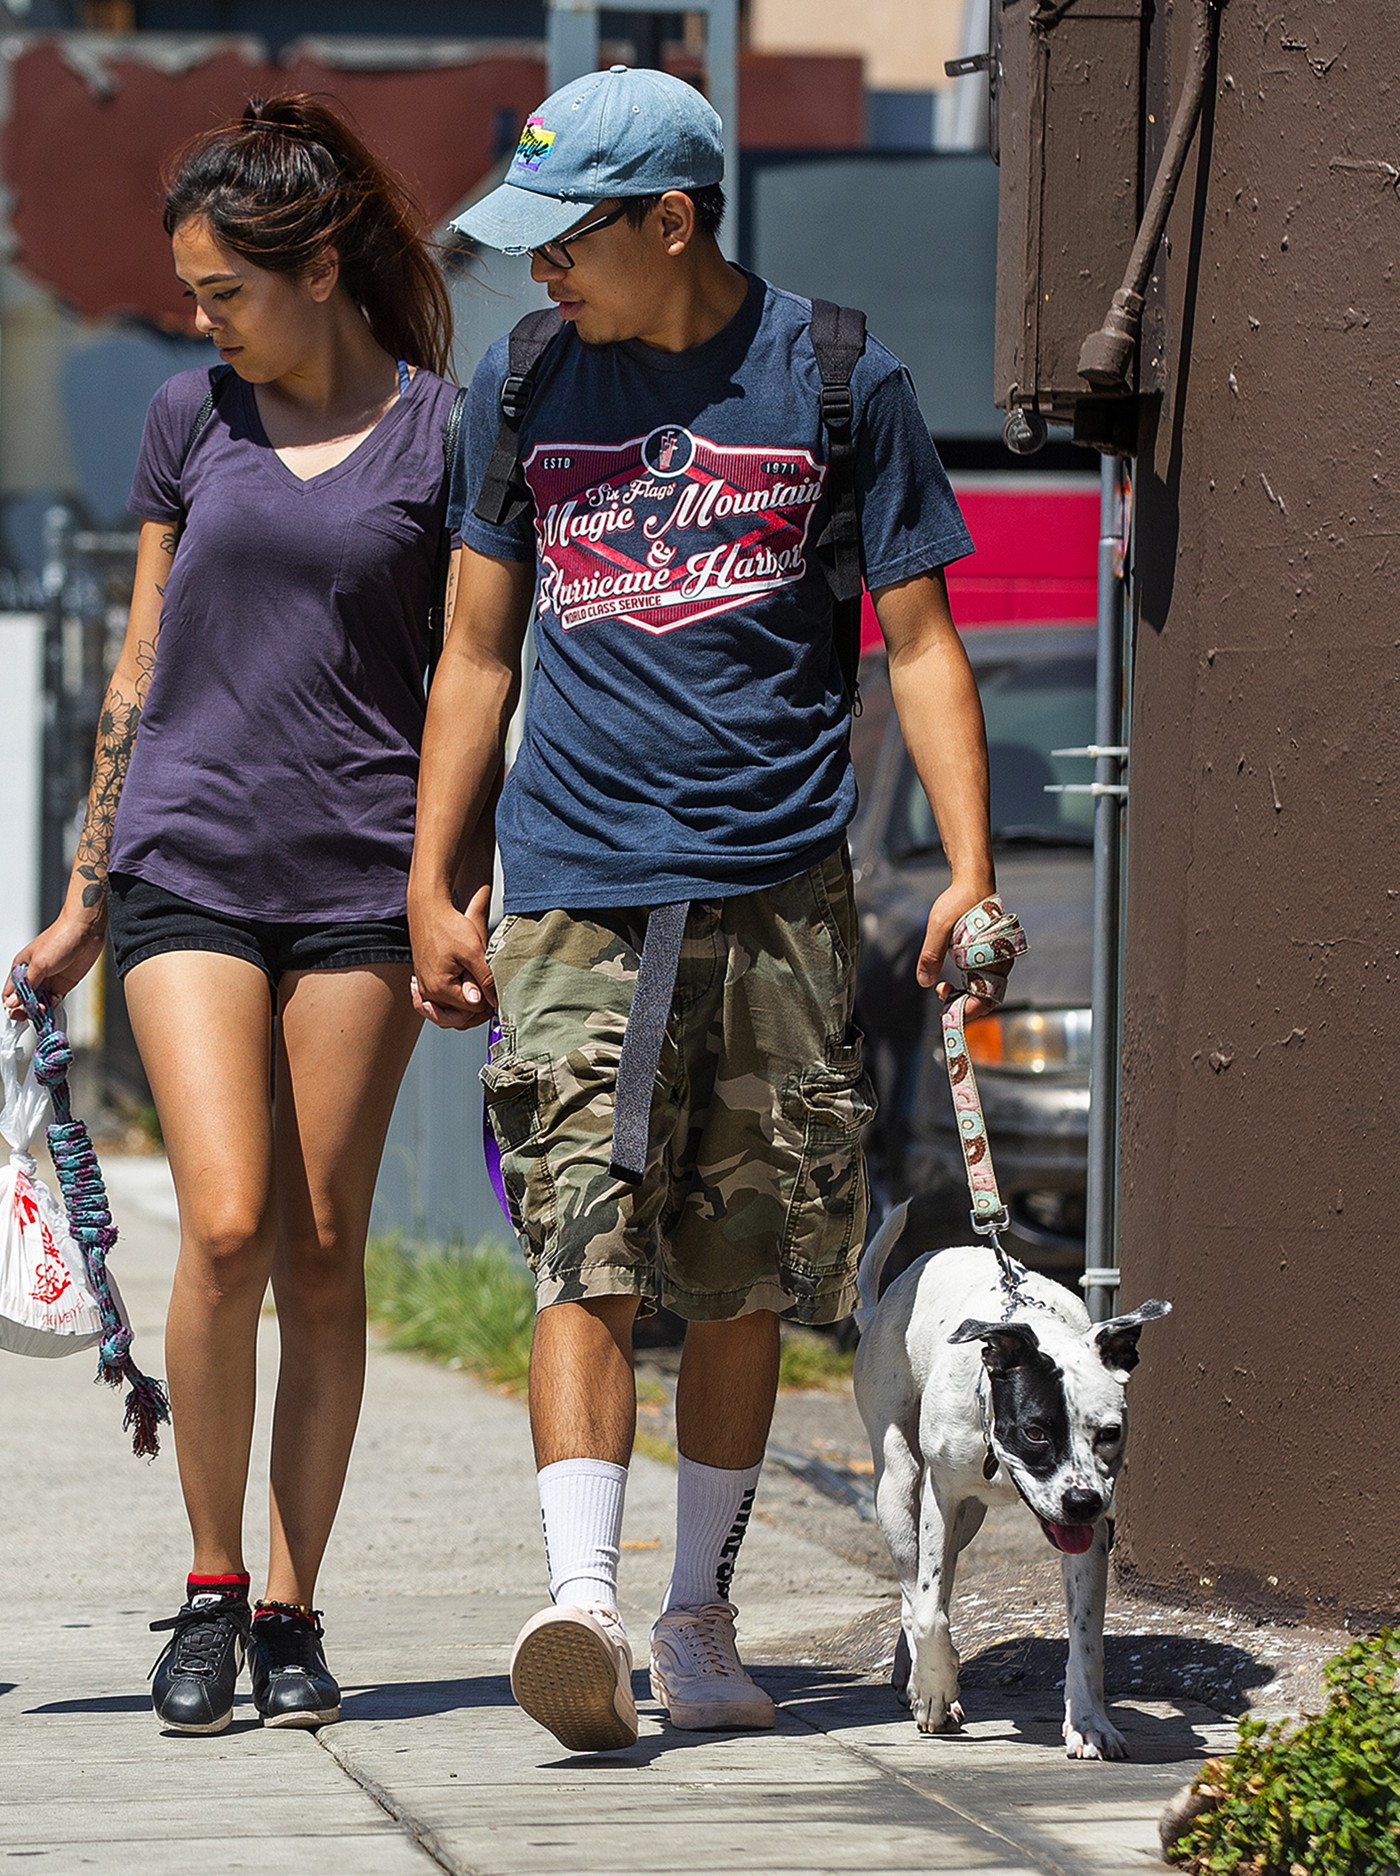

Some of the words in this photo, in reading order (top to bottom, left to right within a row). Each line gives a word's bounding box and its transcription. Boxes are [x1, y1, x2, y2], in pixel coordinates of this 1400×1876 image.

[543, 457, 571, 470] ESTD
[766, 462, 797, 475] 1971
[585, 482, 620, 508] Six
[622, 478, 675, 505] Flags
[533, 500, 635, 557] Magic
[643, 477, 823, 541] Mountain
[646, 538, 677, 570] &
[537, 556, 673, 616] Hurricane
[681, 543, 803, 598] Harbor
[563, 608, 588, 625] WORLD
[588, 603, 617, 620] CLASS
[619, 595, 662, 612] SERVICE
